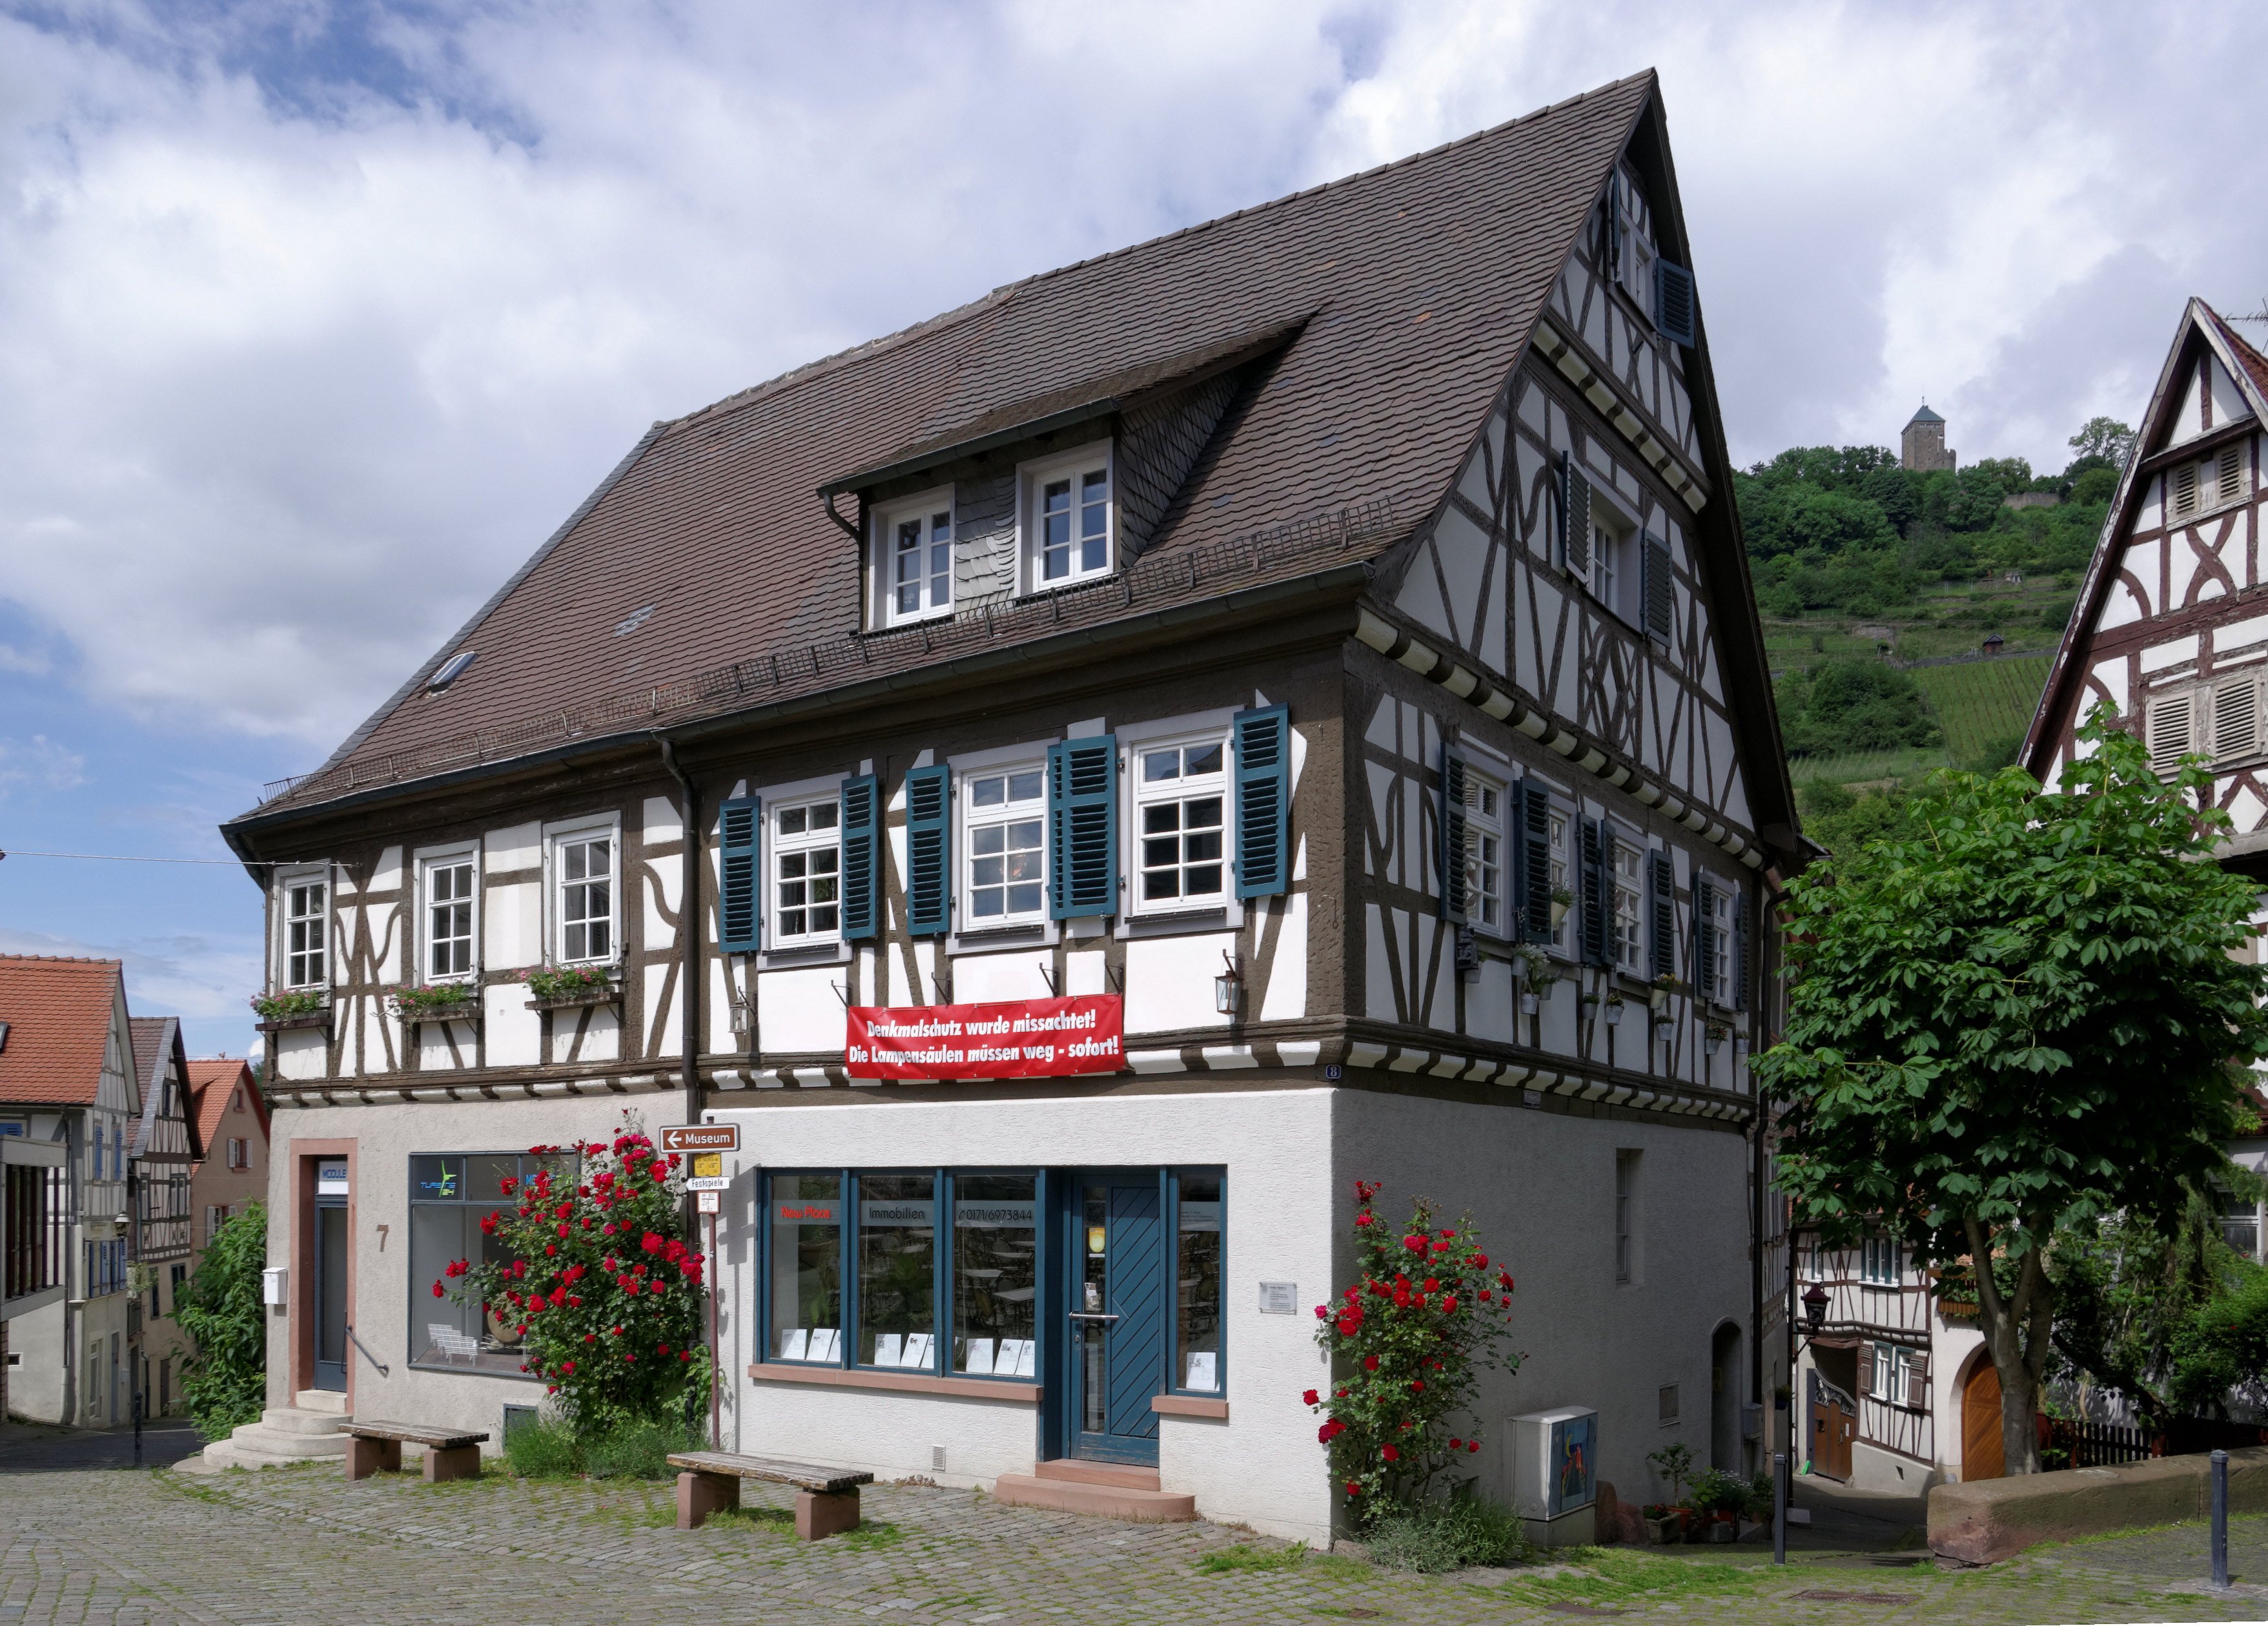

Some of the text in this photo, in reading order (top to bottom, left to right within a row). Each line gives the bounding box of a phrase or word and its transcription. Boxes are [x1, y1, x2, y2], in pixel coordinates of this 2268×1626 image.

[866, 1009, 1096, 1037] Denkmalschutz wurde missachtet!
[849, 1045, 868, 1063] Die
[872, 1044, 963, 1067] Lampensäulen
[967, 1044, 1020, 1062] müssen
[1023, 1045, 1054, 1062] weg
[1068, 1035, 1119, 1058] sofort!
[1330, 1065, 1337, 1077] 8
[685, 1133, 730, 1144] Museum
[323, 1169, 347, 1178] MODULE
[691, 1178, 724, 1189] Festspiele
[781, 1206, 831, 1219] New Place
[869, 1207, 925, 1219] Immobilien
[966, 1209, 1033, 1221] 0171/6973844
[376, 1224, 389, 1253] 7
